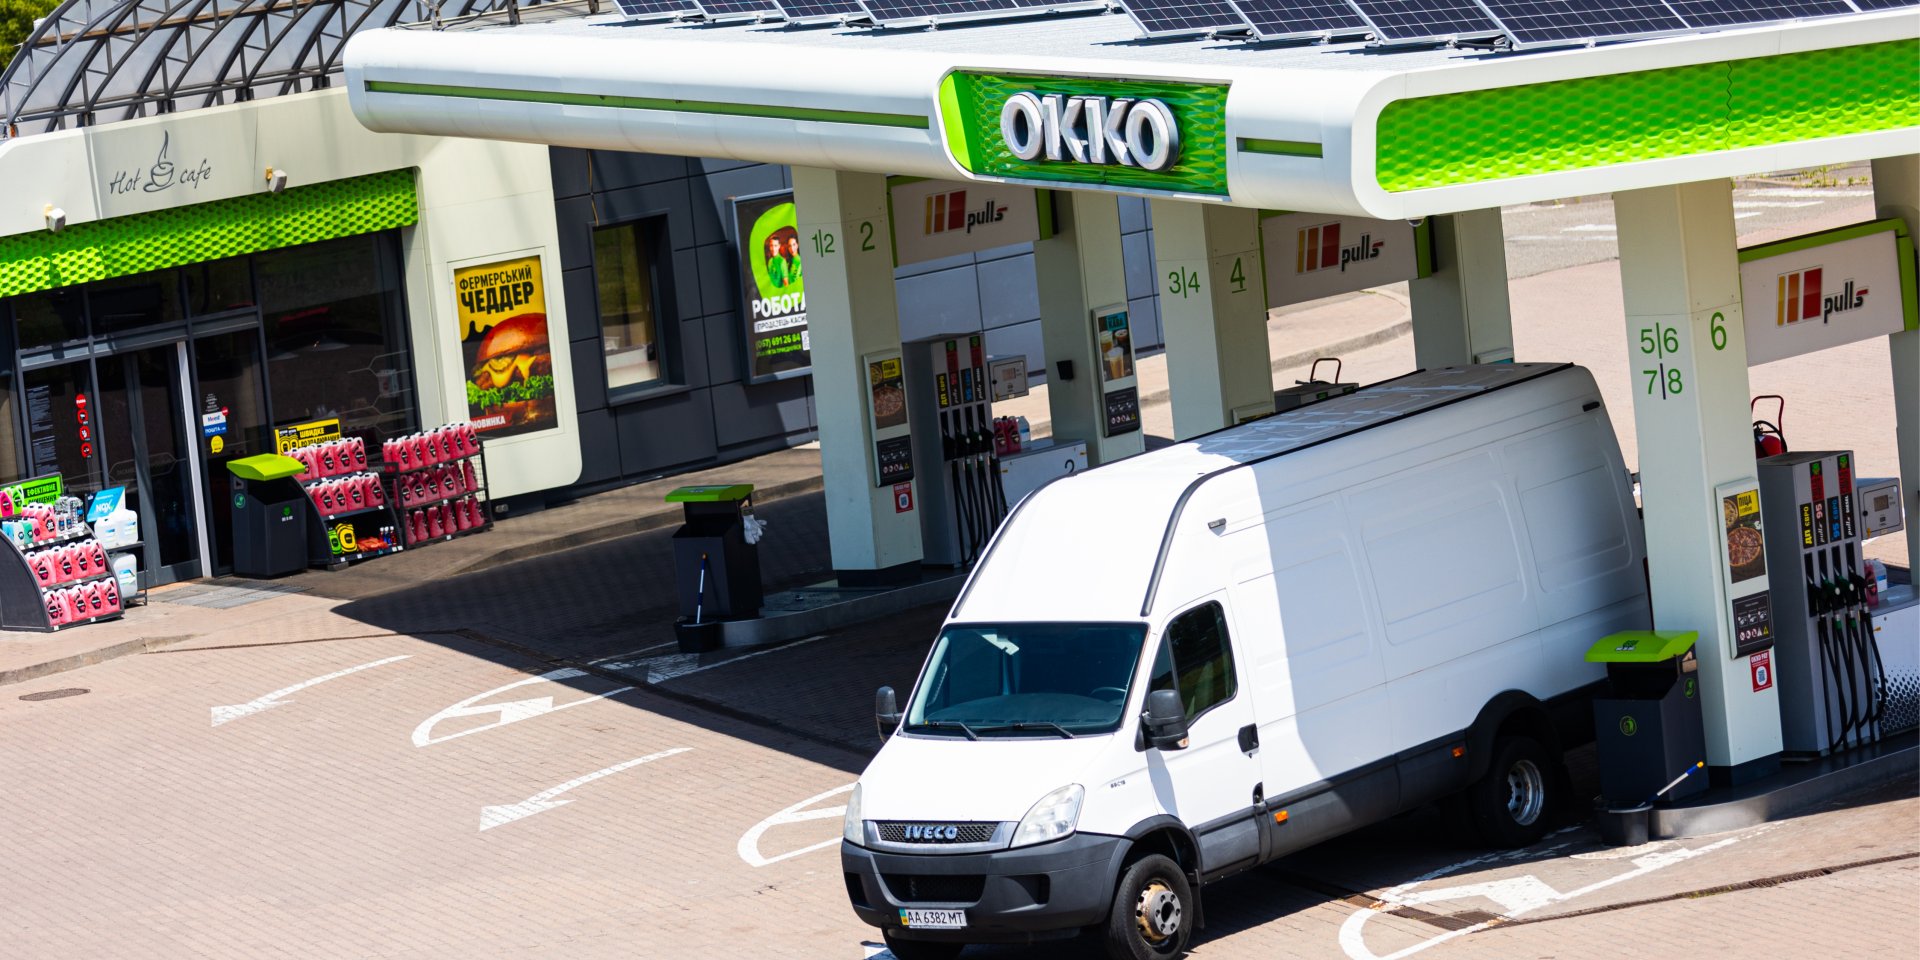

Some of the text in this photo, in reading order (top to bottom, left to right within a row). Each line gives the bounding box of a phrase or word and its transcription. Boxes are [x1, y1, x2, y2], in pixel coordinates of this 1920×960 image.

[1000, 91, 1179, 171] OKKO
[110, 158, 211, 194] Hot cafe
[967, 200, 1008, 234] pulls
[860, 221, 875, 251] 2
[1341, 234, 1384, 272] pulls
[459, 264, 532, 291] ФЕРМЕРСЬКИЙ
[1230, 257, 1246, 292] 4
[460, 281, 534, 315] ЧЕДДЕР
[1823, 281, 1869, 324] pulls
[1710, 311, 1727, 351] 6
[1816, 503, 1823, 520] 95
[1805, 531, 1813, 545] ДП
[1833, 521, 1841, 539] 95
[904, 825, 959, 840] IVECO
[908, 911, 964, 925] AA 6382 MT
